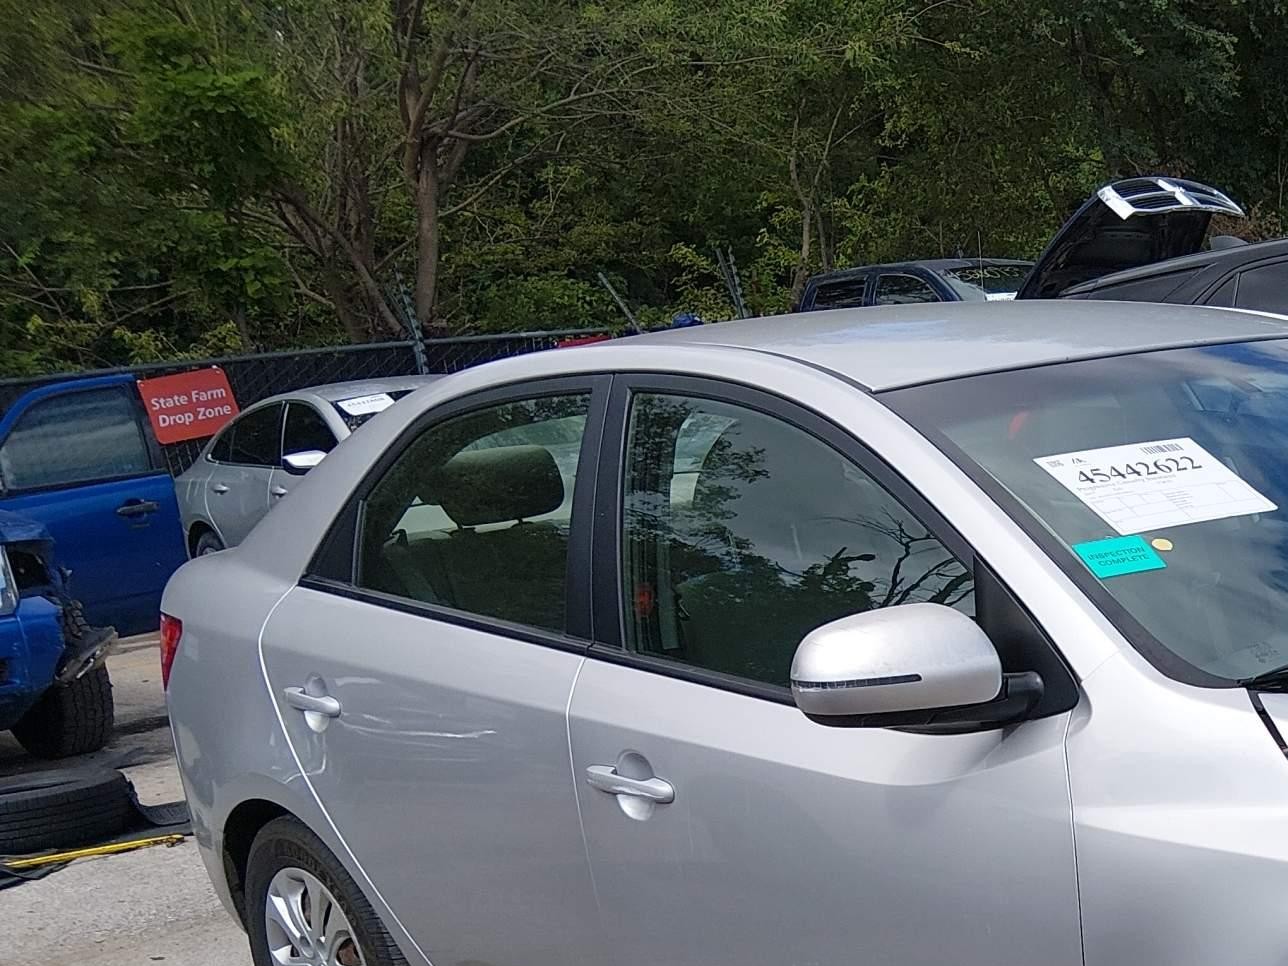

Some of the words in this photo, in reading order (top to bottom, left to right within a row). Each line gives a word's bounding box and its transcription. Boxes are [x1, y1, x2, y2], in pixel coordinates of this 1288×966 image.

[151, 395, 189, 410] State
[191, 388, 226, 402] Farm
[158, 412, 194, 427] Drop
[196, 405, 232, 420] Zone
[1078, 456, 1202, 484] 45442622
[1087, 547, 1146, 560] INSPECTION
[1098, 554, 1149, 567] COMPLETE
